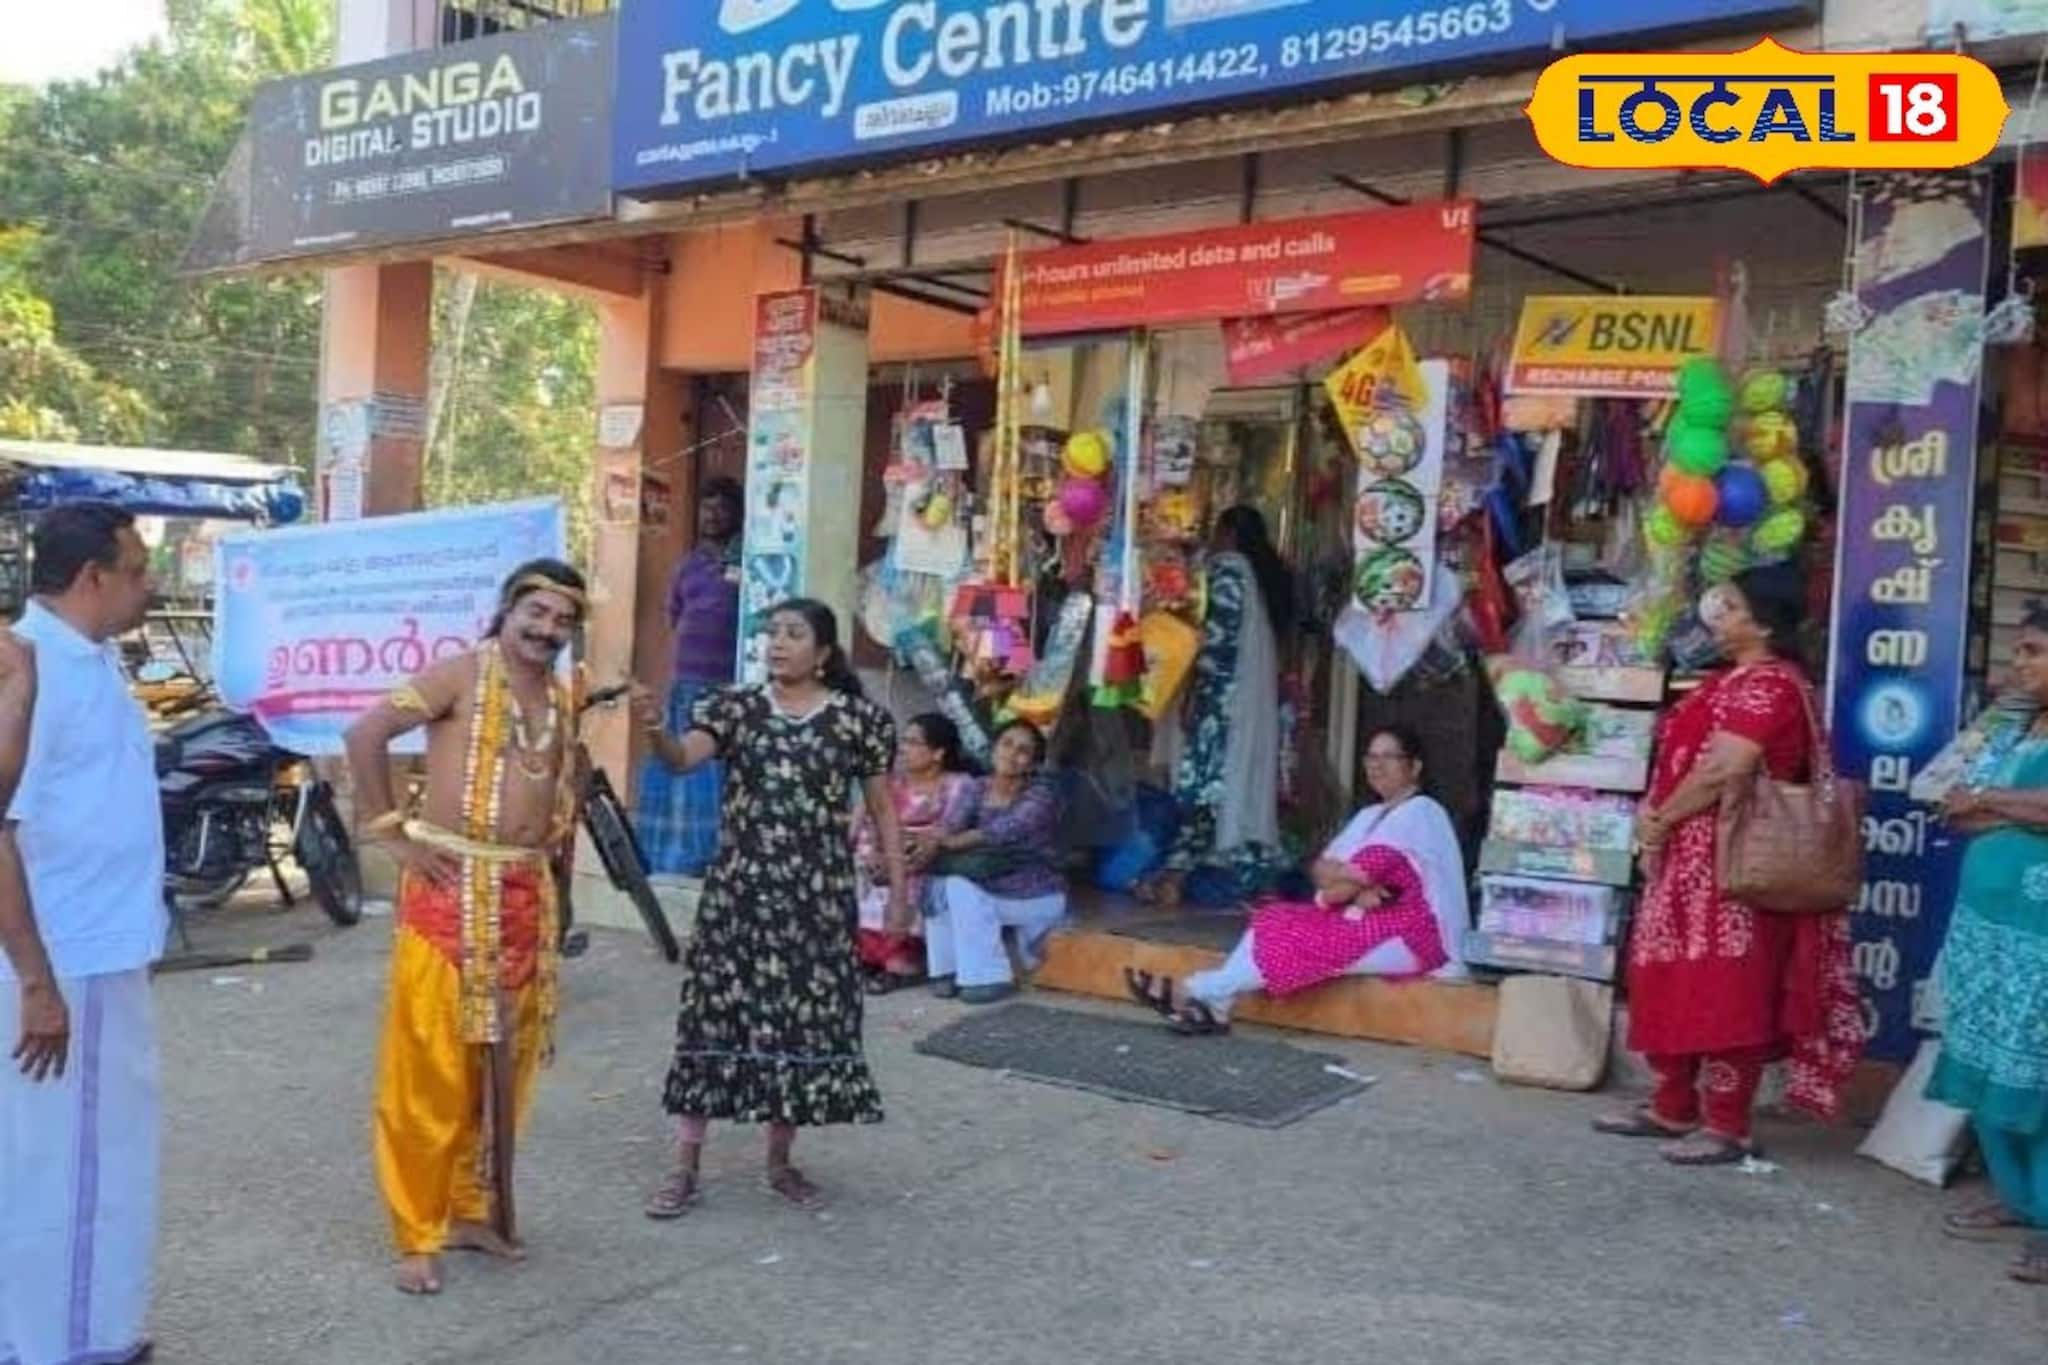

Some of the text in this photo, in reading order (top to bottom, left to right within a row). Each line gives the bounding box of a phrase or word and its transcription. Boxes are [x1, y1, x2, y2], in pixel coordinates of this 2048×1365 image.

[320, 54, 525, 130] GANGA
[660, 33, 861, 126] Fancy
[880, 0, 1150, 86] Centre
[986, 43, 1268, 116] Mob:9746414422,
[1280, 3, 1512, 67] 8129545663
[305, 92, 542, 167] DIGITAL STUDIO
[1024, 231, 1336, 285] -hours unlimited data and calls
[1588, 312, 1705, 354] BSNL
